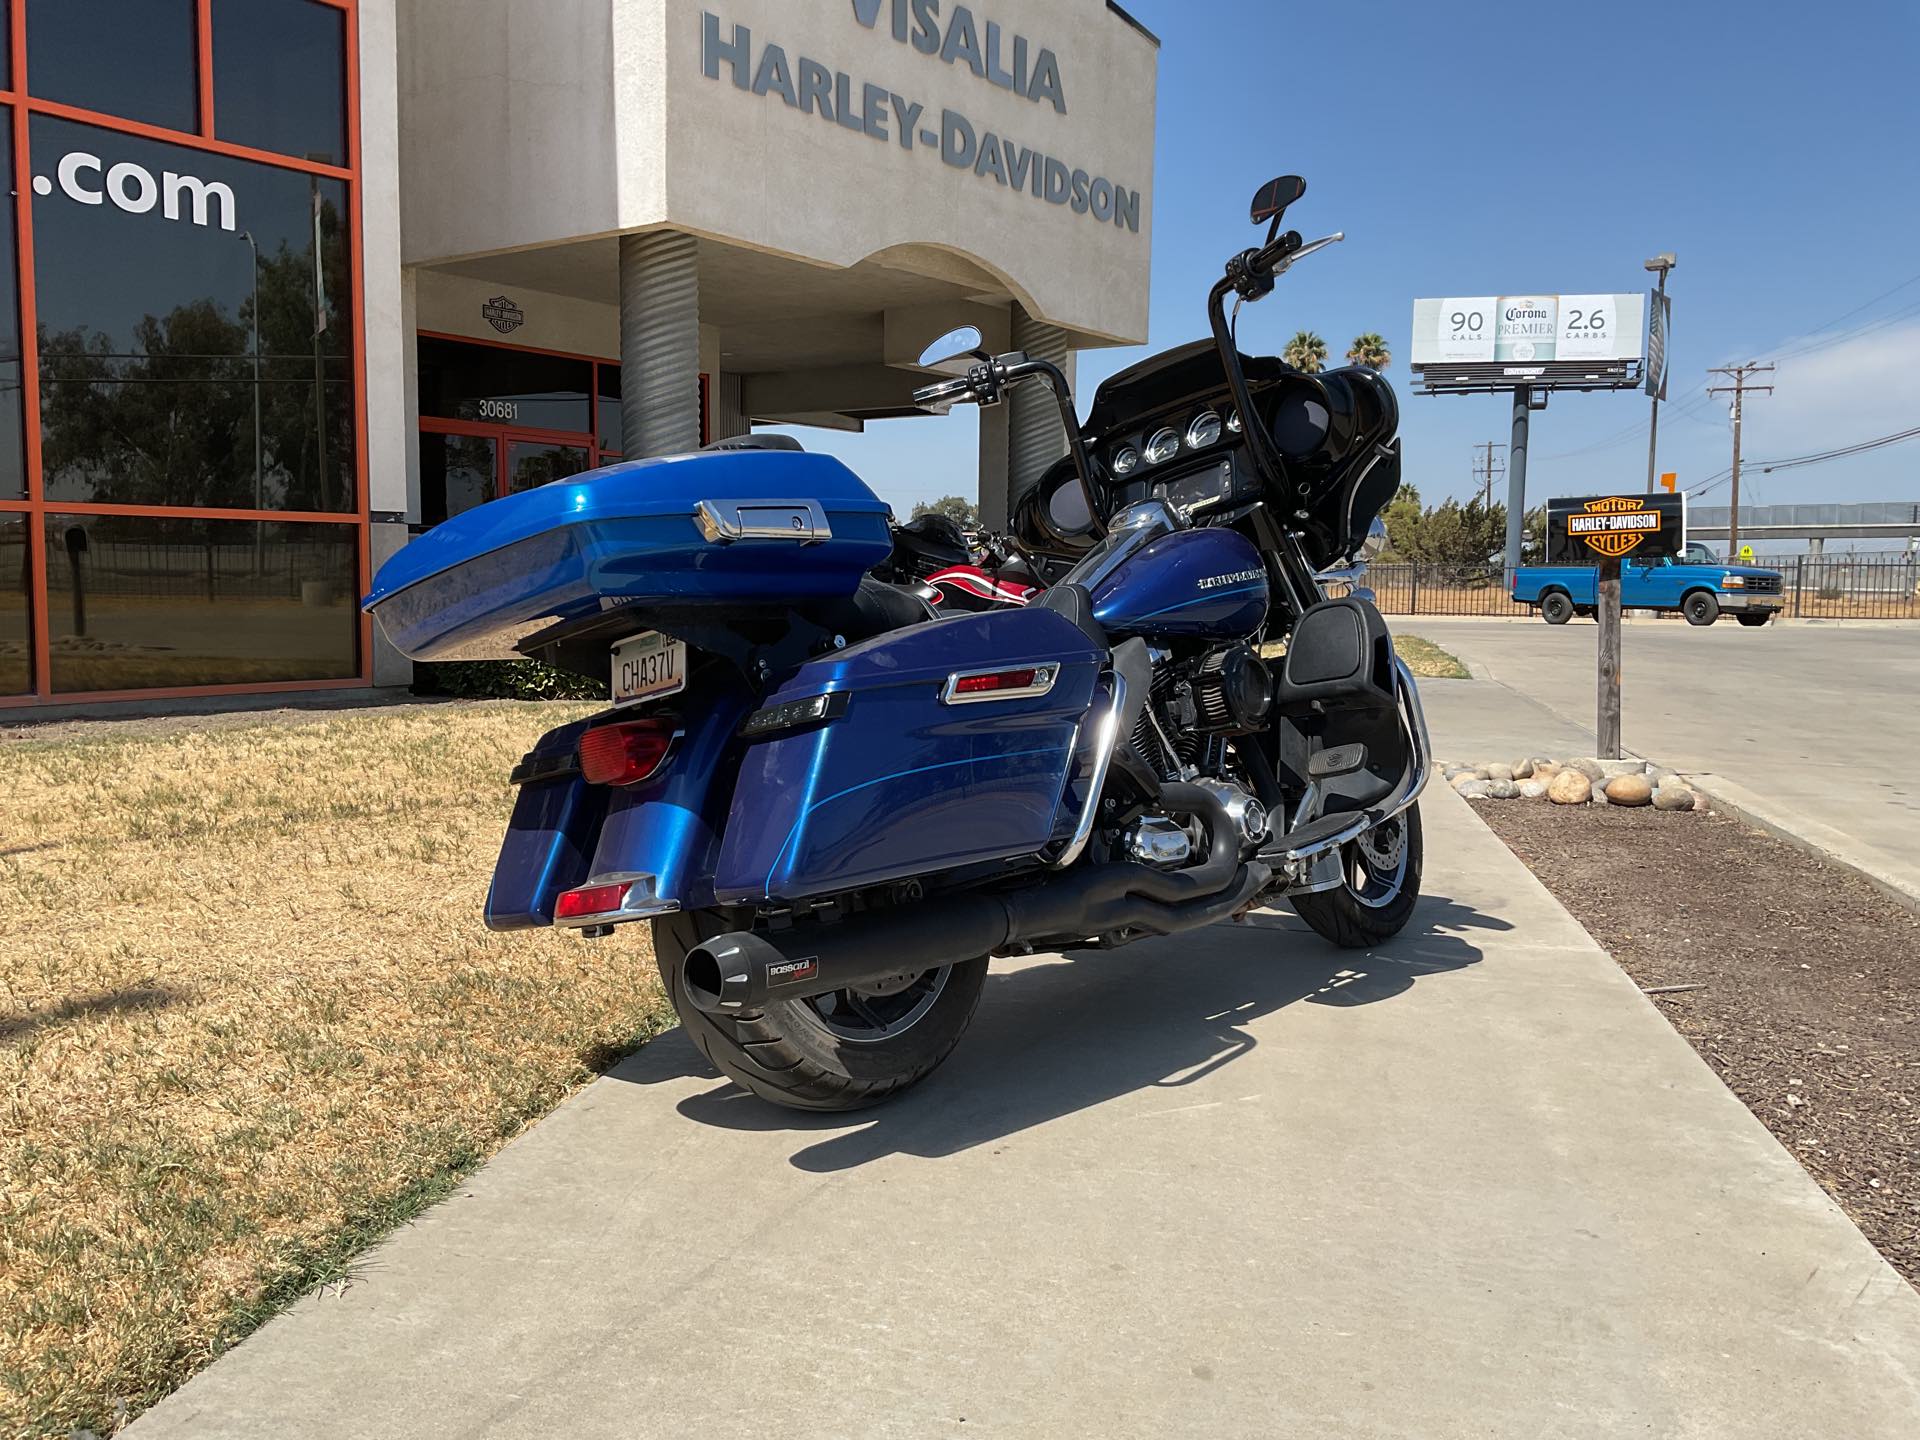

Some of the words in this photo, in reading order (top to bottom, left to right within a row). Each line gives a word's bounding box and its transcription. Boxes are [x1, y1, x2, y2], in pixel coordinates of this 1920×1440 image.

[702, 11, 1140, 233] HARLEY-DAVIDSON
[32, 152, 236, 231] .com
[1451, 312, 1483, 331] 90
[1505, 307, 1547, 322] Corona
[1567, 309, 1605, 330] 2.6
[1498, 323, 1553, 335] PREMIER
[479, 399, 518, 420] 30681
[1591, 500, 1637, 513] MOTOR
[1571, 514, 1657, 532] HARLEY-DAVIDSON
[1591, 533, 1637, 553] CYCLES
[622, 648, 674, 692] CHA37V
